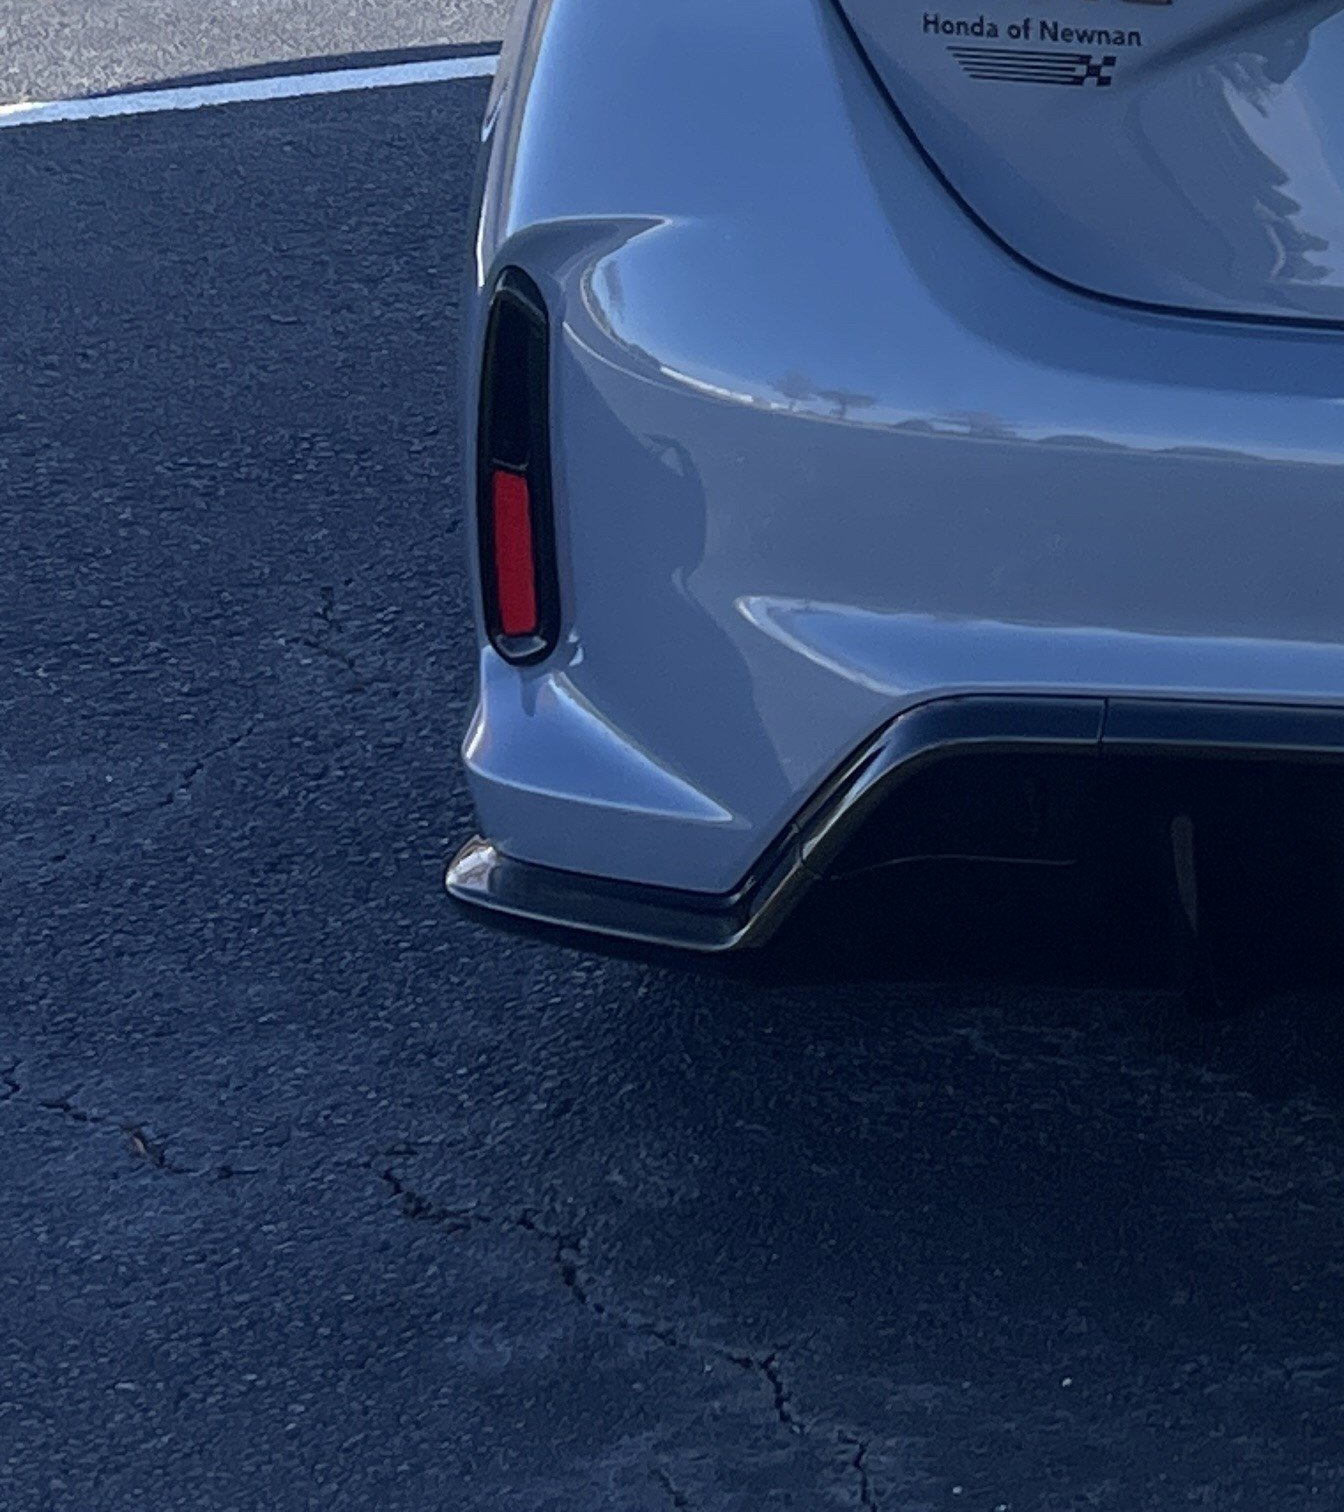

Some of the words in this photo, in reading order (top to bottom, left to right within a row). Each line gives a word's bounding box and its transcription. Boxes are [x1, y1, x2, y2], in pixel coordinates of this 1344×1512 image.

[922, 12, 999, 38] Honda
[1007, 17, 1031, 39] of
[1039, 19, 1142, 47] Newnan
